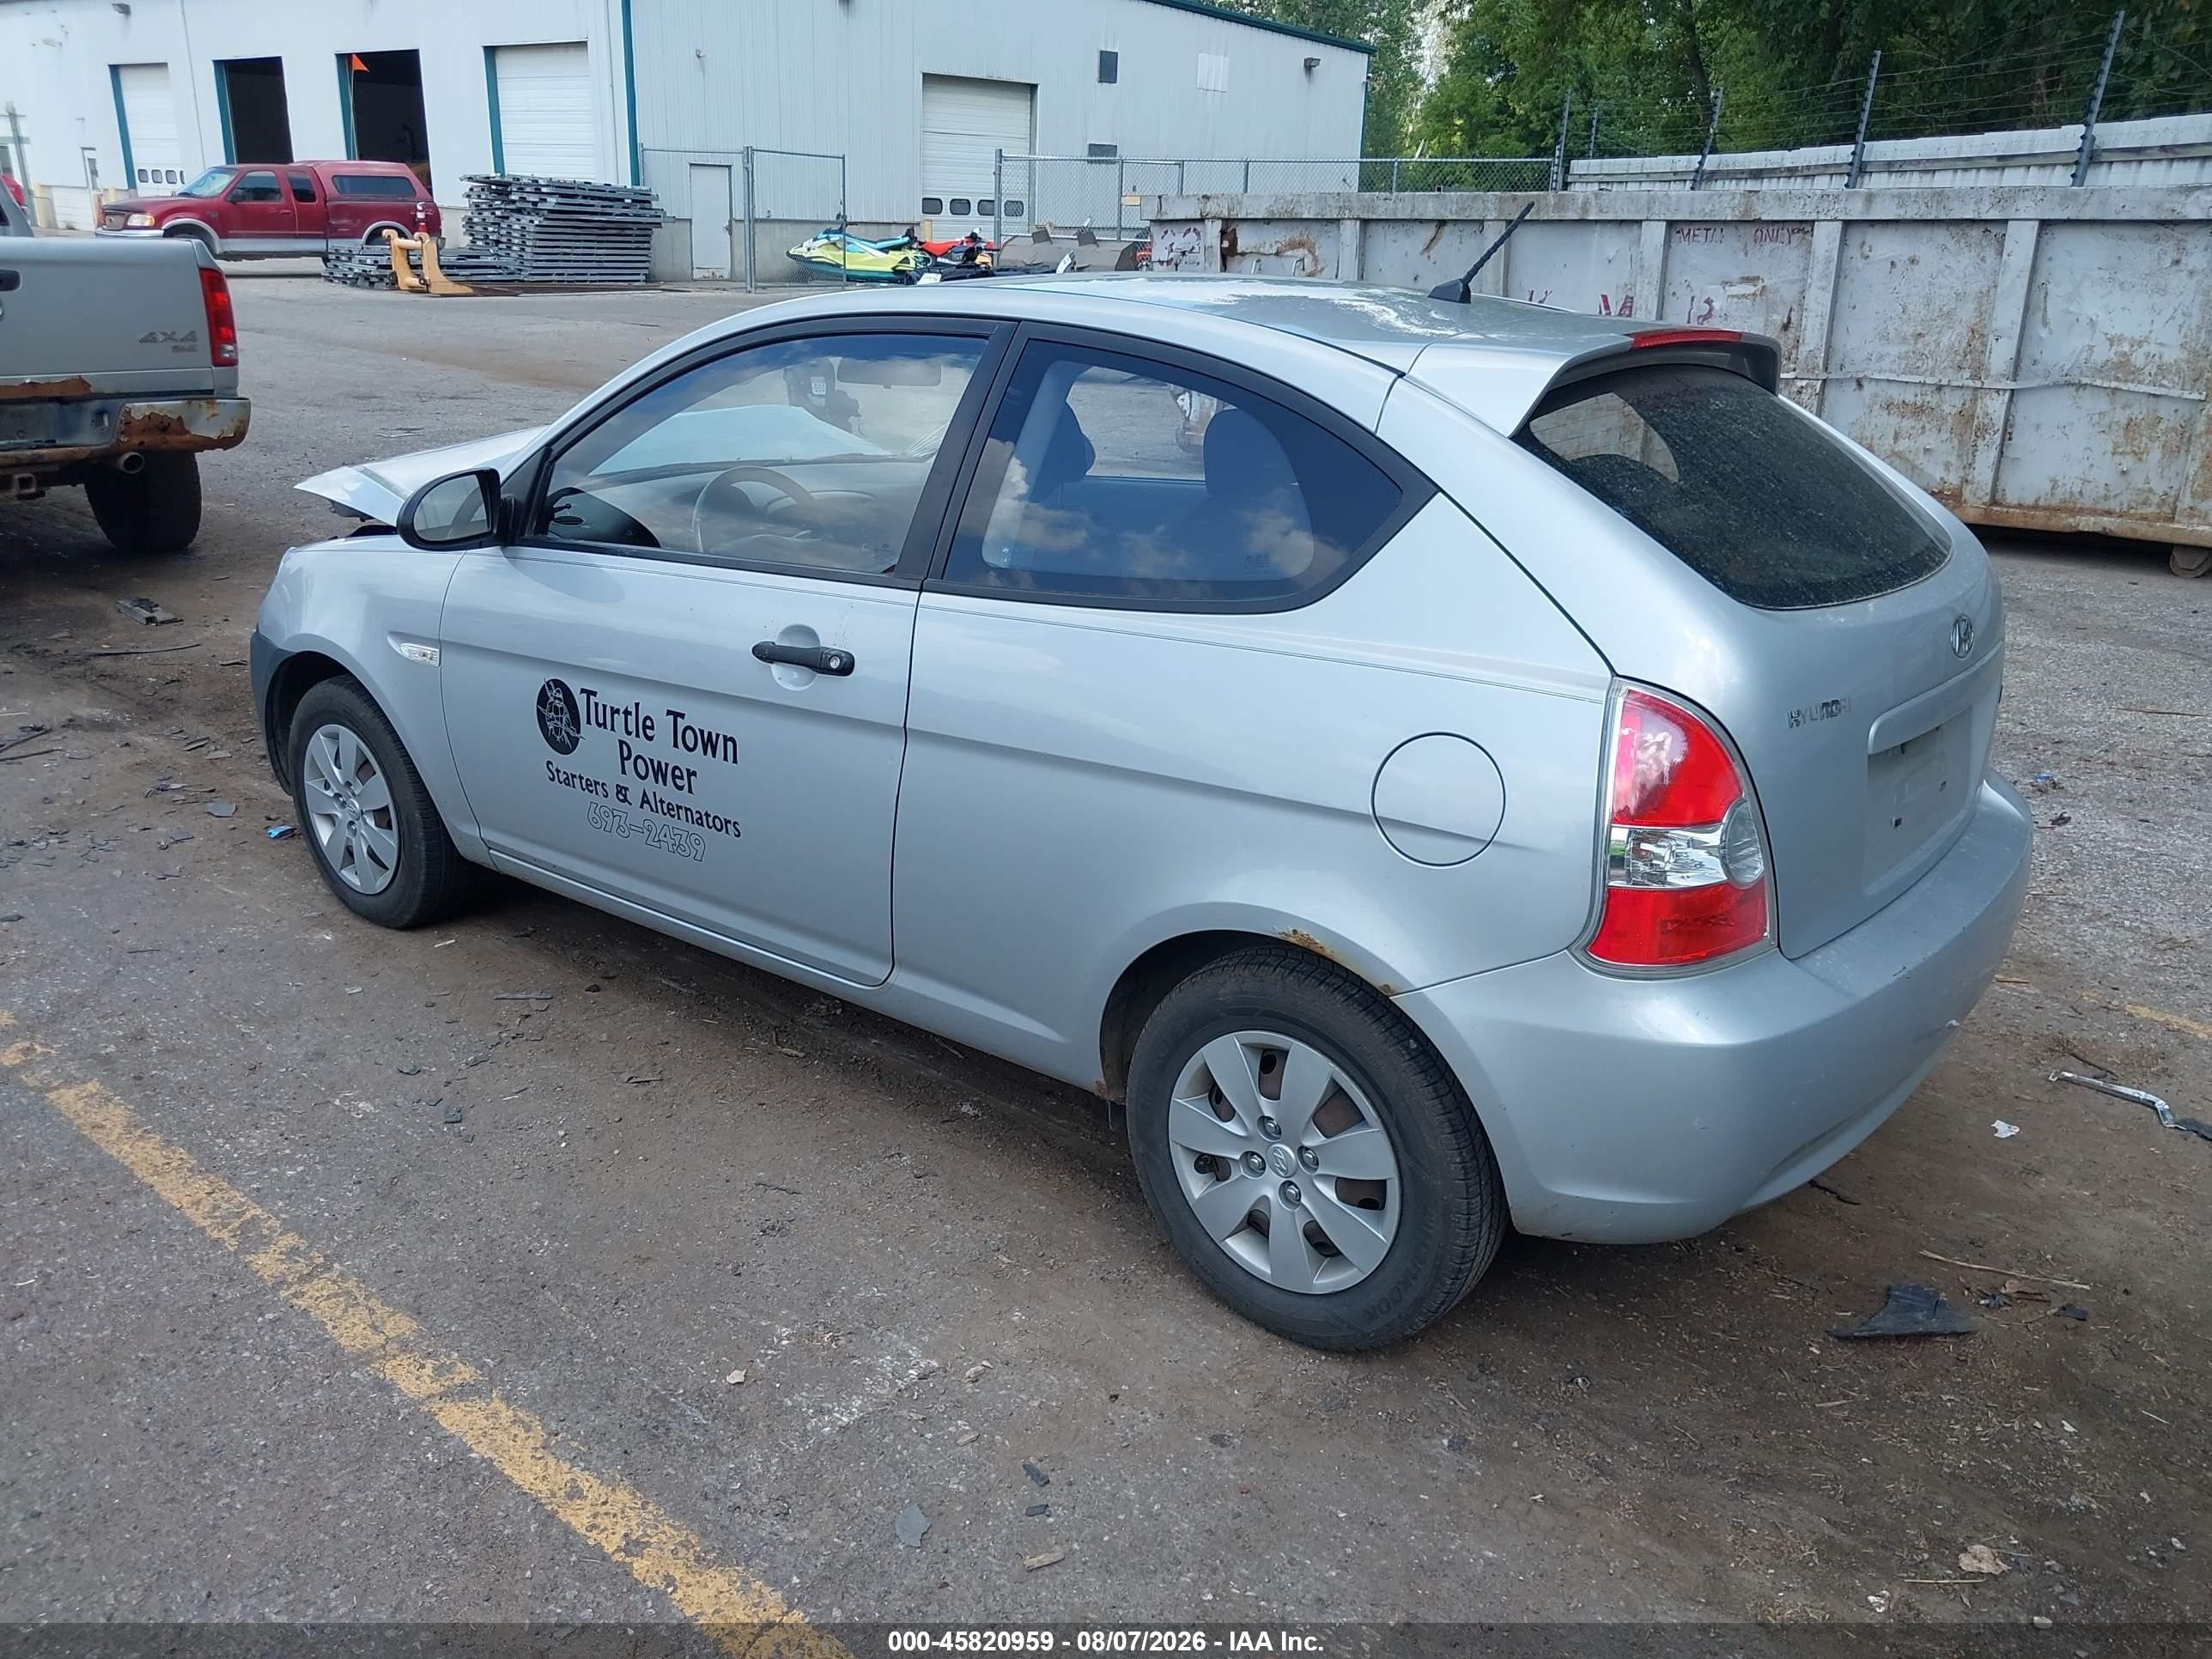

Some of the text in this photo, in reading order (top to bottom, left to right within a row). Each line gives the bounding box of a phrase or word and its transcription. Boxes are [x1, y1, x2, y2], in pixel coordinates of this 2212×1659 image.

[579, 688, 739, 764] Turtle Town
[545, 760, 742, 838] Starters & Alternators
[617, 739, 698, 795] Power
[586, 800, 707, 862] 693-2439
